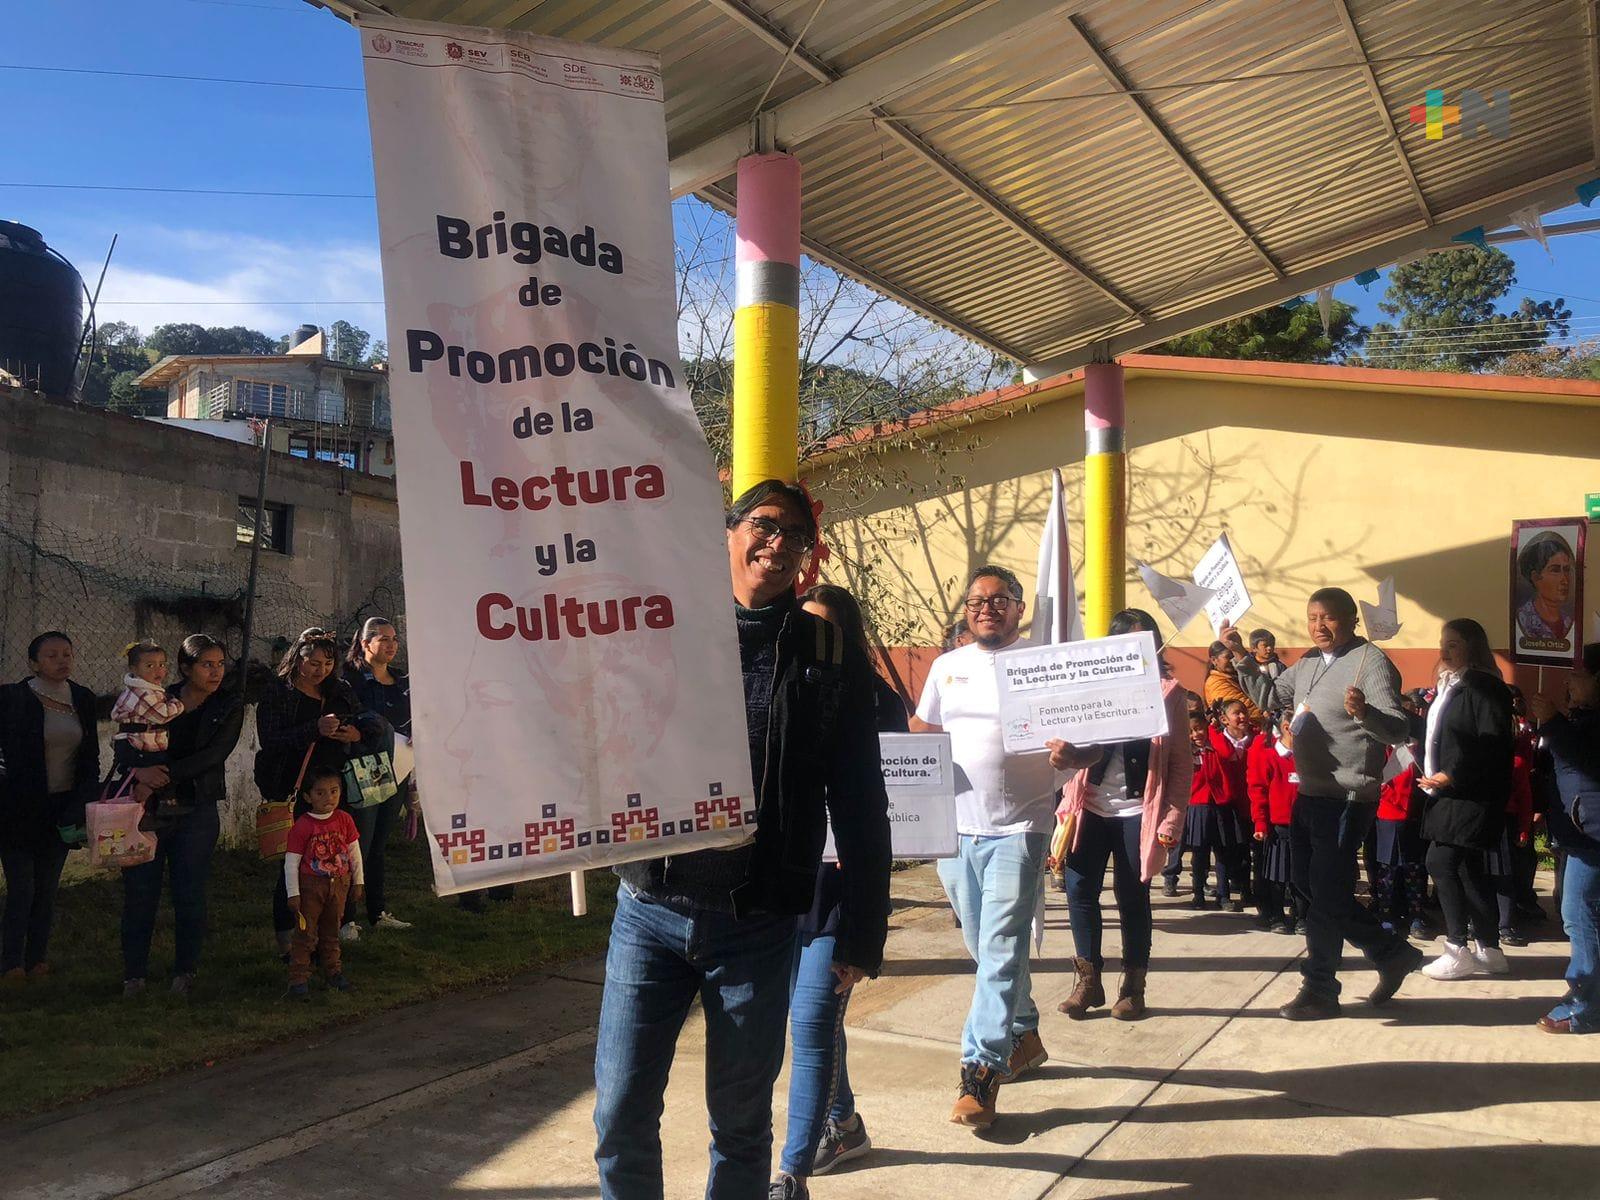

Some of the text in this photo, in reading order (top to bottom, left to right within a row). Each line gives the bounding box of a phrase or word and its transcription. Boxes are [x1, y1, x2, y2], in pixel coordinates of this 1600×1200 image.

[468, 49, 487, 58] SEV
[510, 50, 531, 62] SEB
[563, 63, 588, 74] SDE
[436, 211, 624, 275] Brigada
[518, 276, 562, 307] de
[406, 329, 676, 389] Promoción
[513, 402, 594, 440] de la
[460, 460, 666, 511] Lectura
[534, 532, 597, 576] y la
[476, 592, 675, 641] Cultura
[1524, 640, 1565, 649] Josefa Ortiz
[1007, 653, 1140, 677] Brigada de Promoción de
[1013, 665, 1135, 686] la Lectura y la Cultura.
[1039, 699, 1113, 716] Fomento para la
[1040, 707, 1141, 727] Lectura y la Escritura.
[880, 755, 937, 766] oción de
[883, 768, 931, 778] Cultura.
[889, 812, 920, 823] ública
